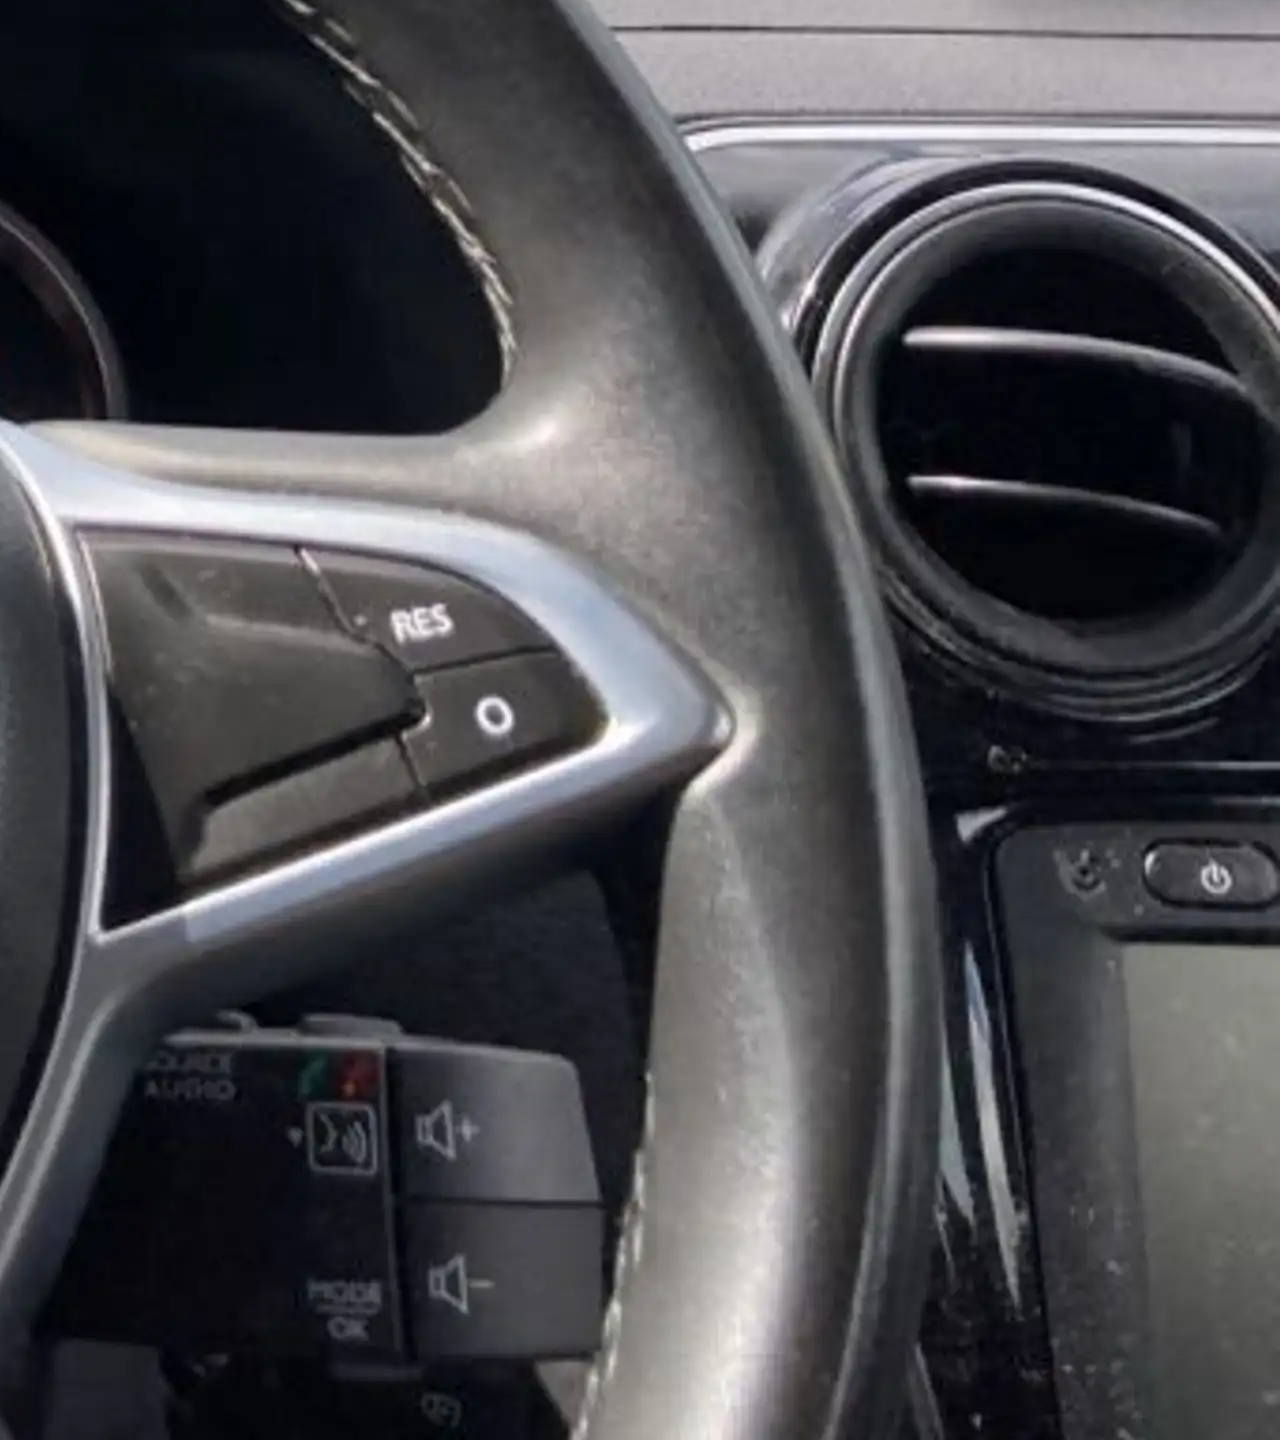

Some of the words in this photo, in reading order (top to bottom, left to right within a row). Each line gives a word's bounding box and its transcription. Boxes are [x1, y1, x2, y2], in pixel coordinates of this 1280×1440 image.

[390, 603, 455, 644] RES
[306, 1277, 382, 1304] MODE
[326, 1315, 370, 1341] OK
